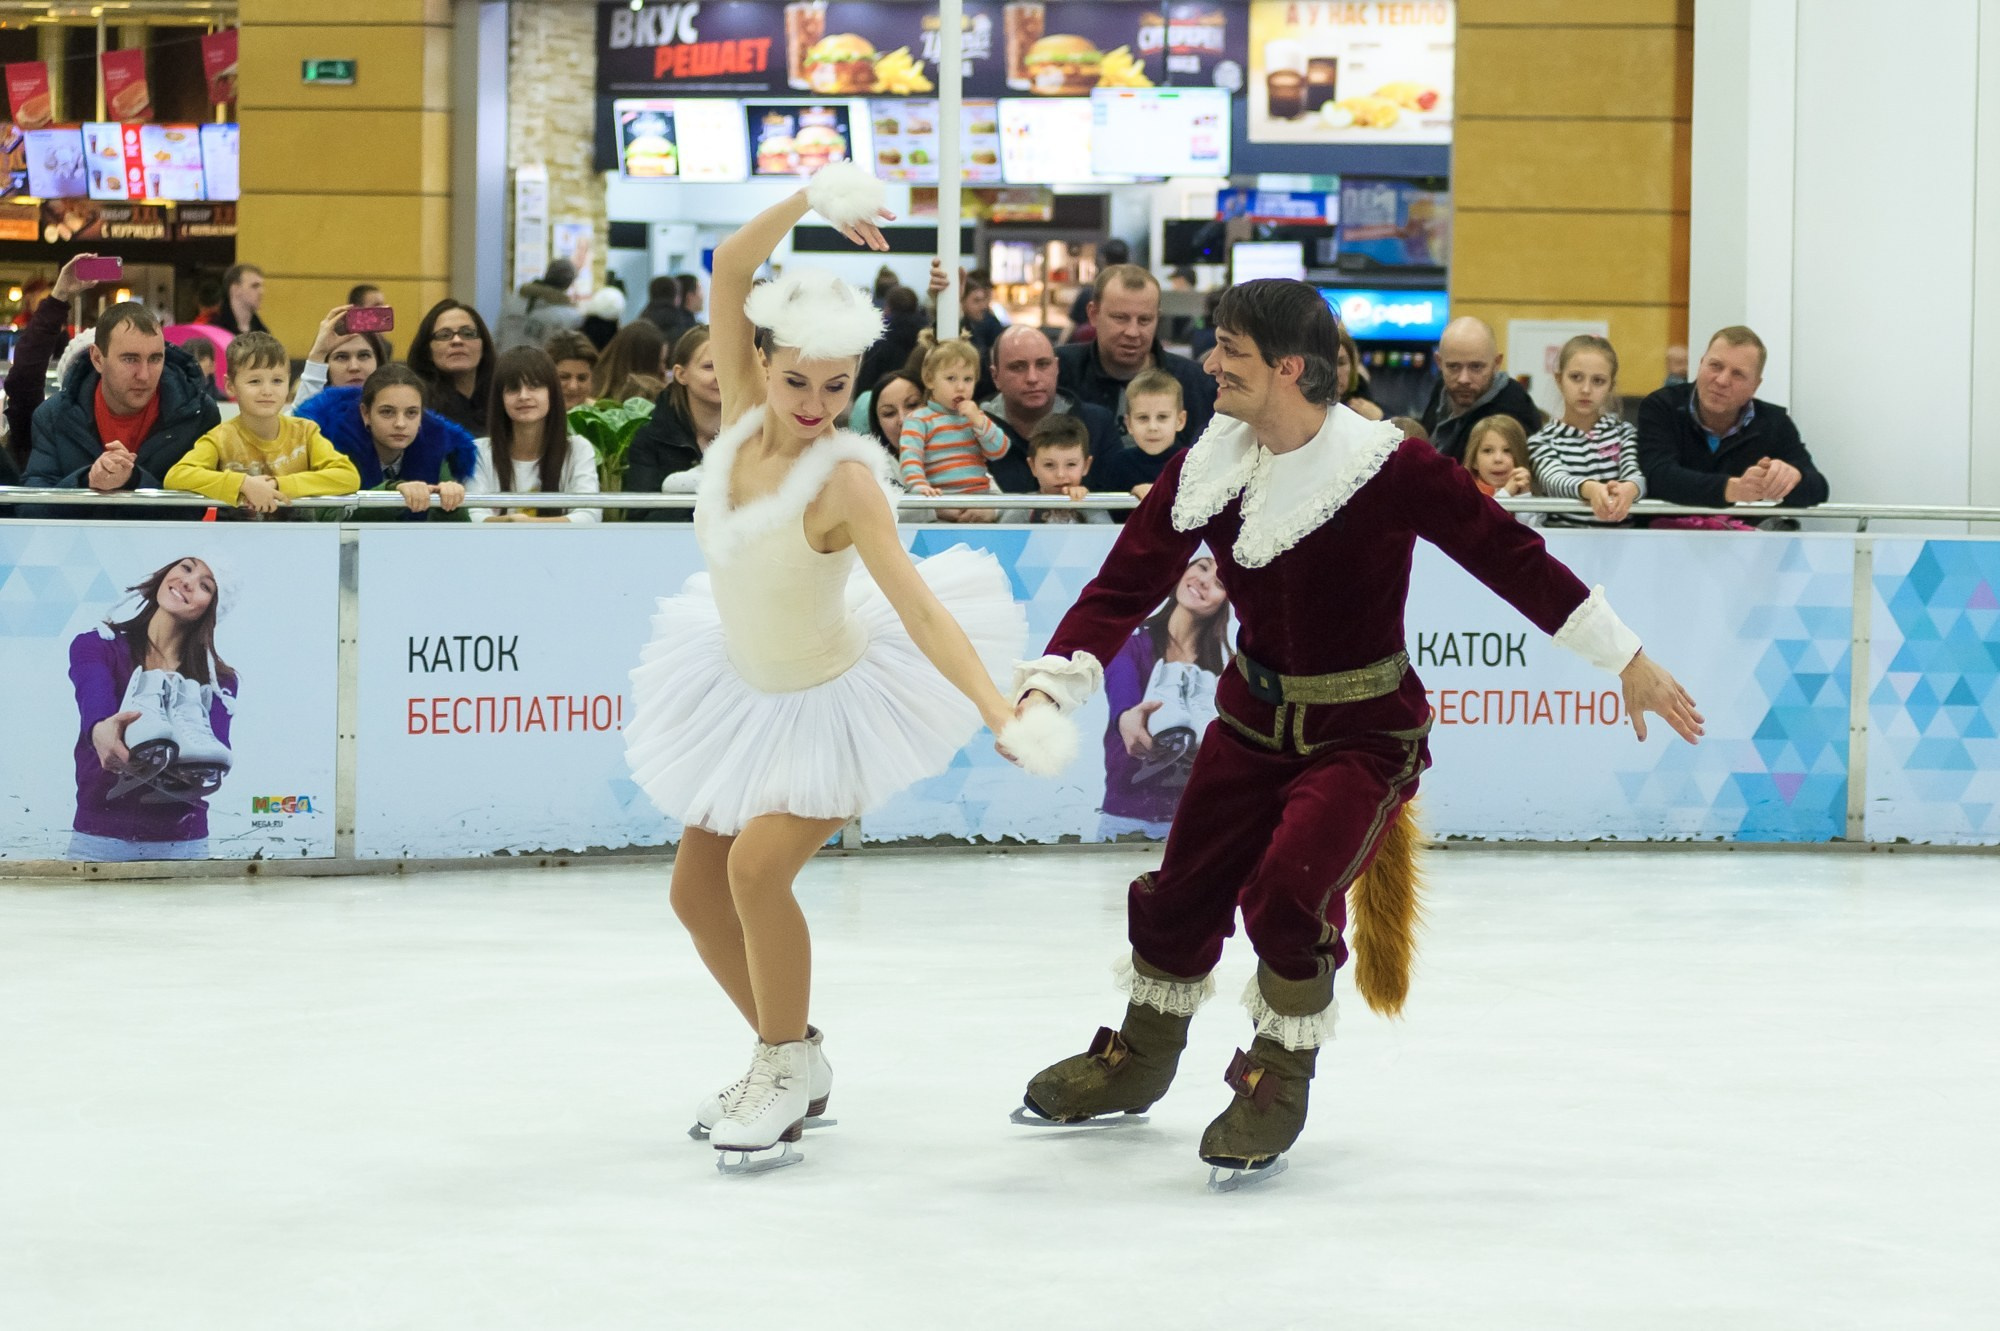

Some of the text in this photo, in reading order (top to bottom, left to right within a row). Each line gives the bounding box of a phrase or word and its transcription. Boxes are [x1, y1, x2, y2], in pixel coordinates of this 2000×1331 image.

[609, 2, 700, 48] ВКУС
[1329, 3, 1369, 26] НАС
[1376, 3, 1447, 26] ТЕПЛО
[653, 37, 772, 79] РЕШАЕТ
[408, 635, 518, 673] КАТОК
[1417, 632, 1526, 667] КАТОК
[407, 694, 622, 735] БЕСПЛАТНО!
[251, 820, 283, 828] MEGA.RU
